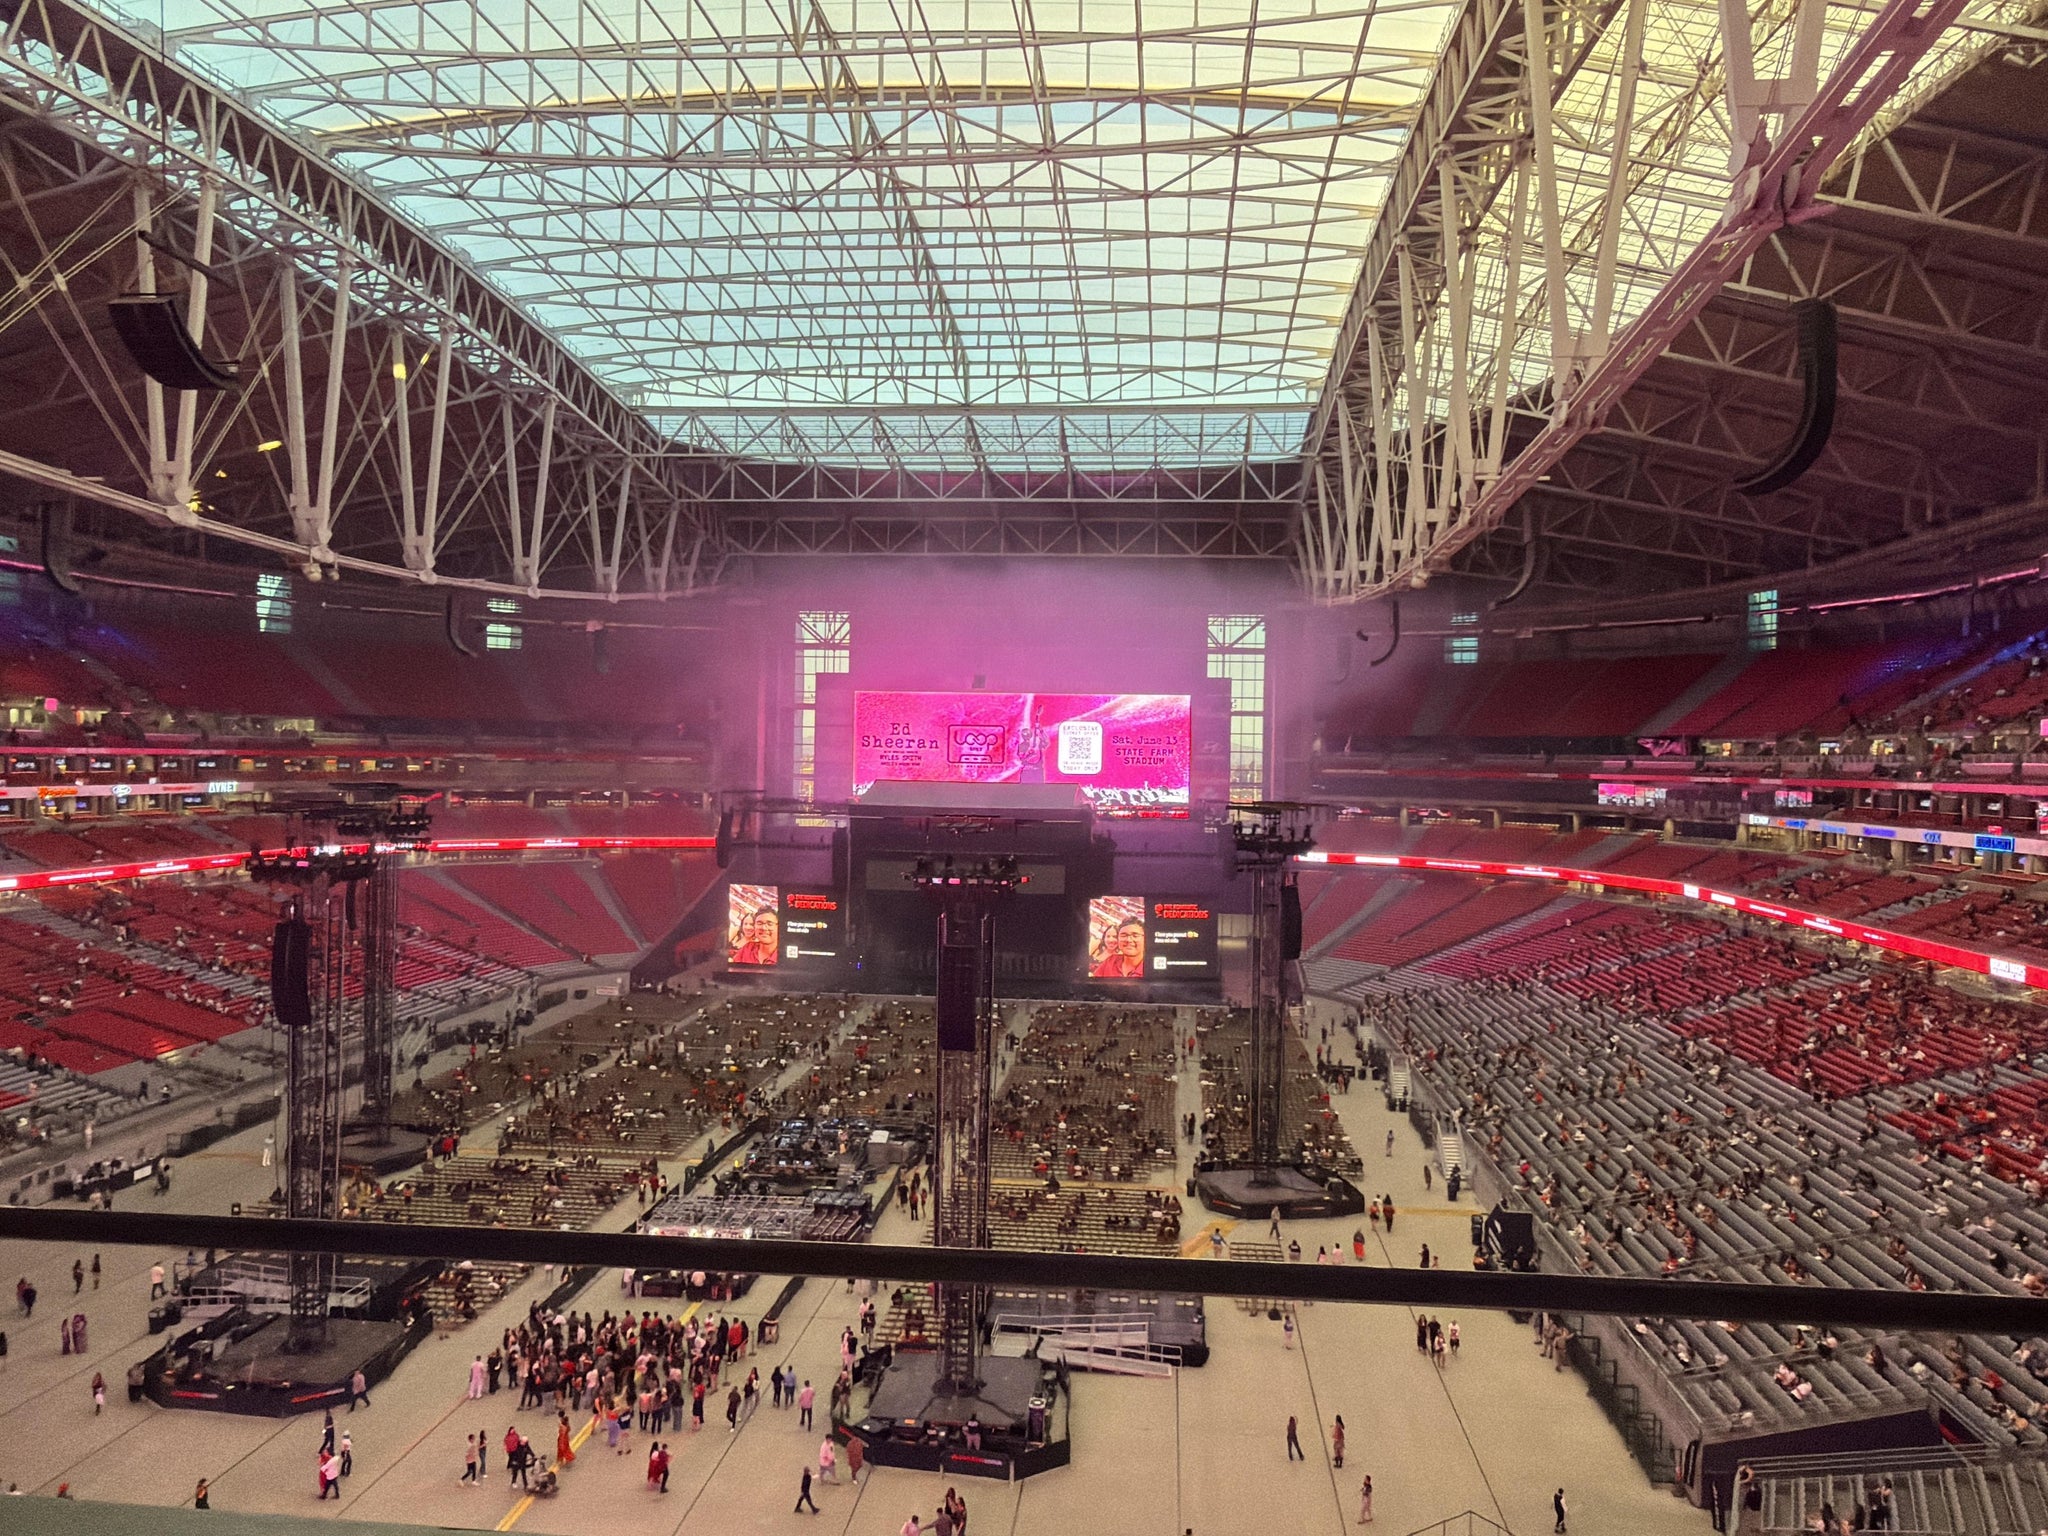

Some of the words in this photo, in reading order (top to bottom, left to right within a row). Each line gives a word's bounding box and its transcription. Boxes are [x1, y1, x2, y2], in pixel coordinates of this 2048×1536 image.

[890, 723, 911, 735] Ed
[862, 735, 939, 749] Sheeran
[1112, 736, 1133, 745] Sat.
[1137, 736, 1162, 745] June
[1116, 748, 1143, 756] STATE
[1124, 757, 1165, 765] STADIUM
